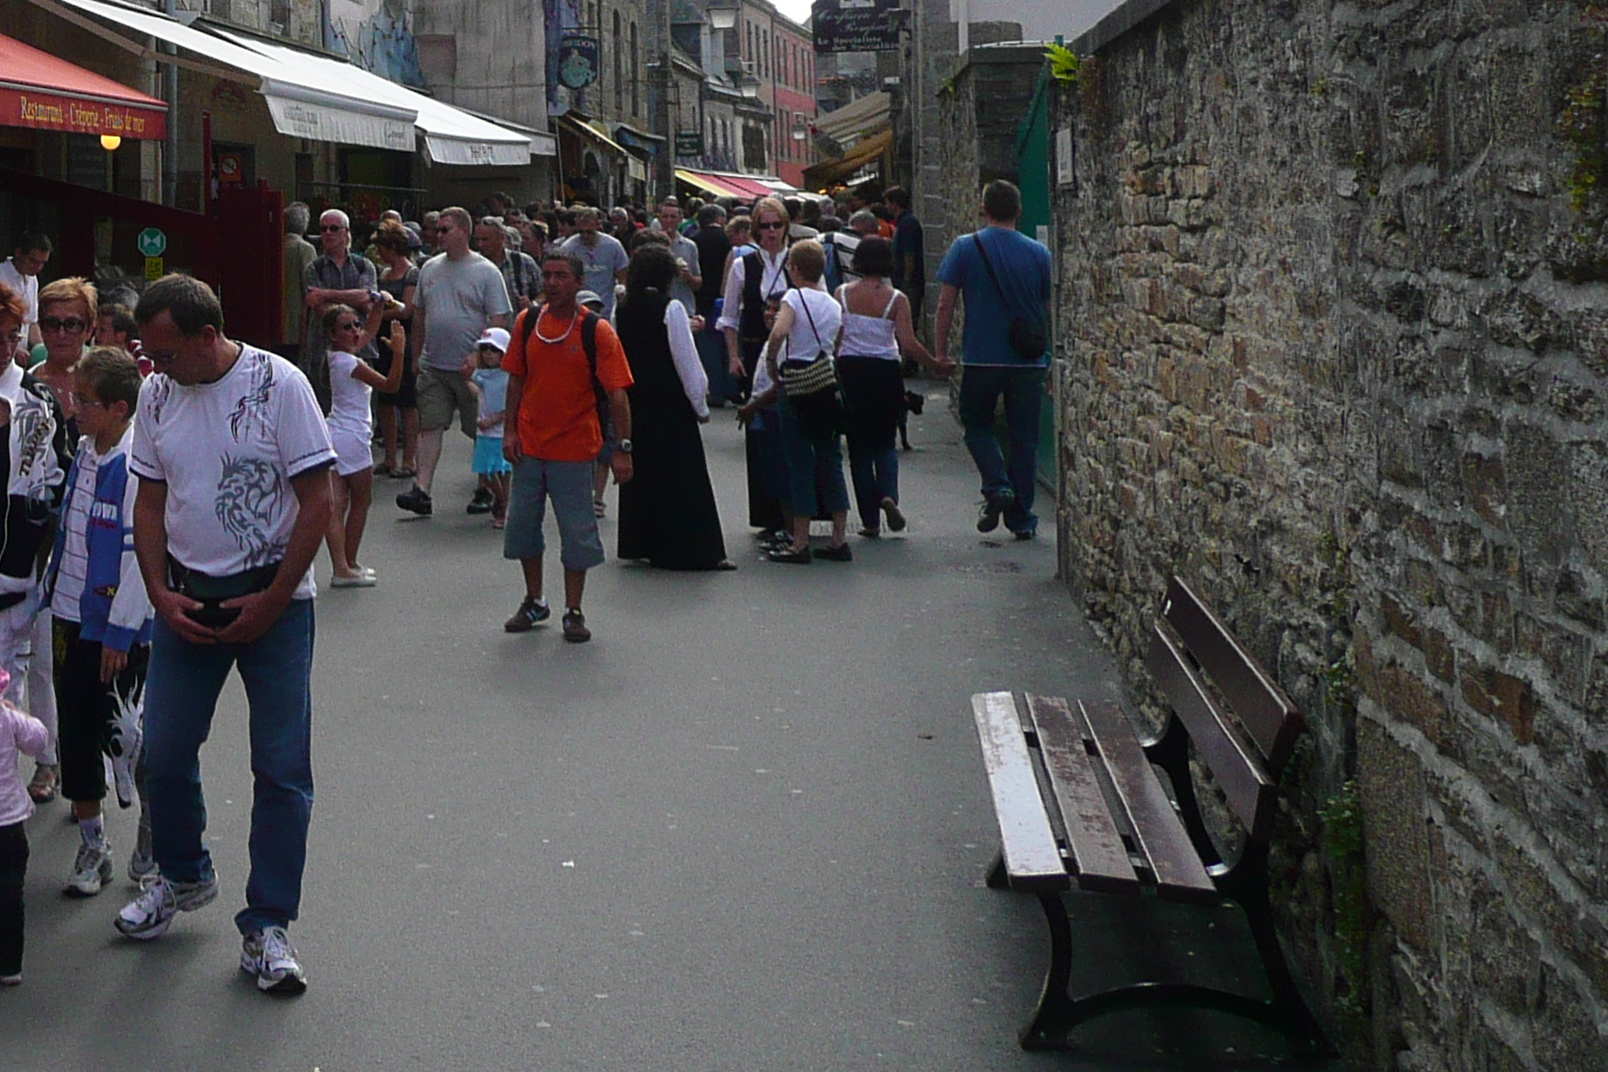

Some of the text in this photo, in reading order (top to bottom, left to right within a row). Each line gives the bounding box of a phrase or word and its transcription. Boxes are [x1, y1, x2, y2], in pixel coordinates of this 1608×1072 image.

[20, 96, 63, 123] Restaurant
[104, 107, 123, 130] Fruits
[125, 108, 132, 130] de
[132, 117, 145, 132] mer
